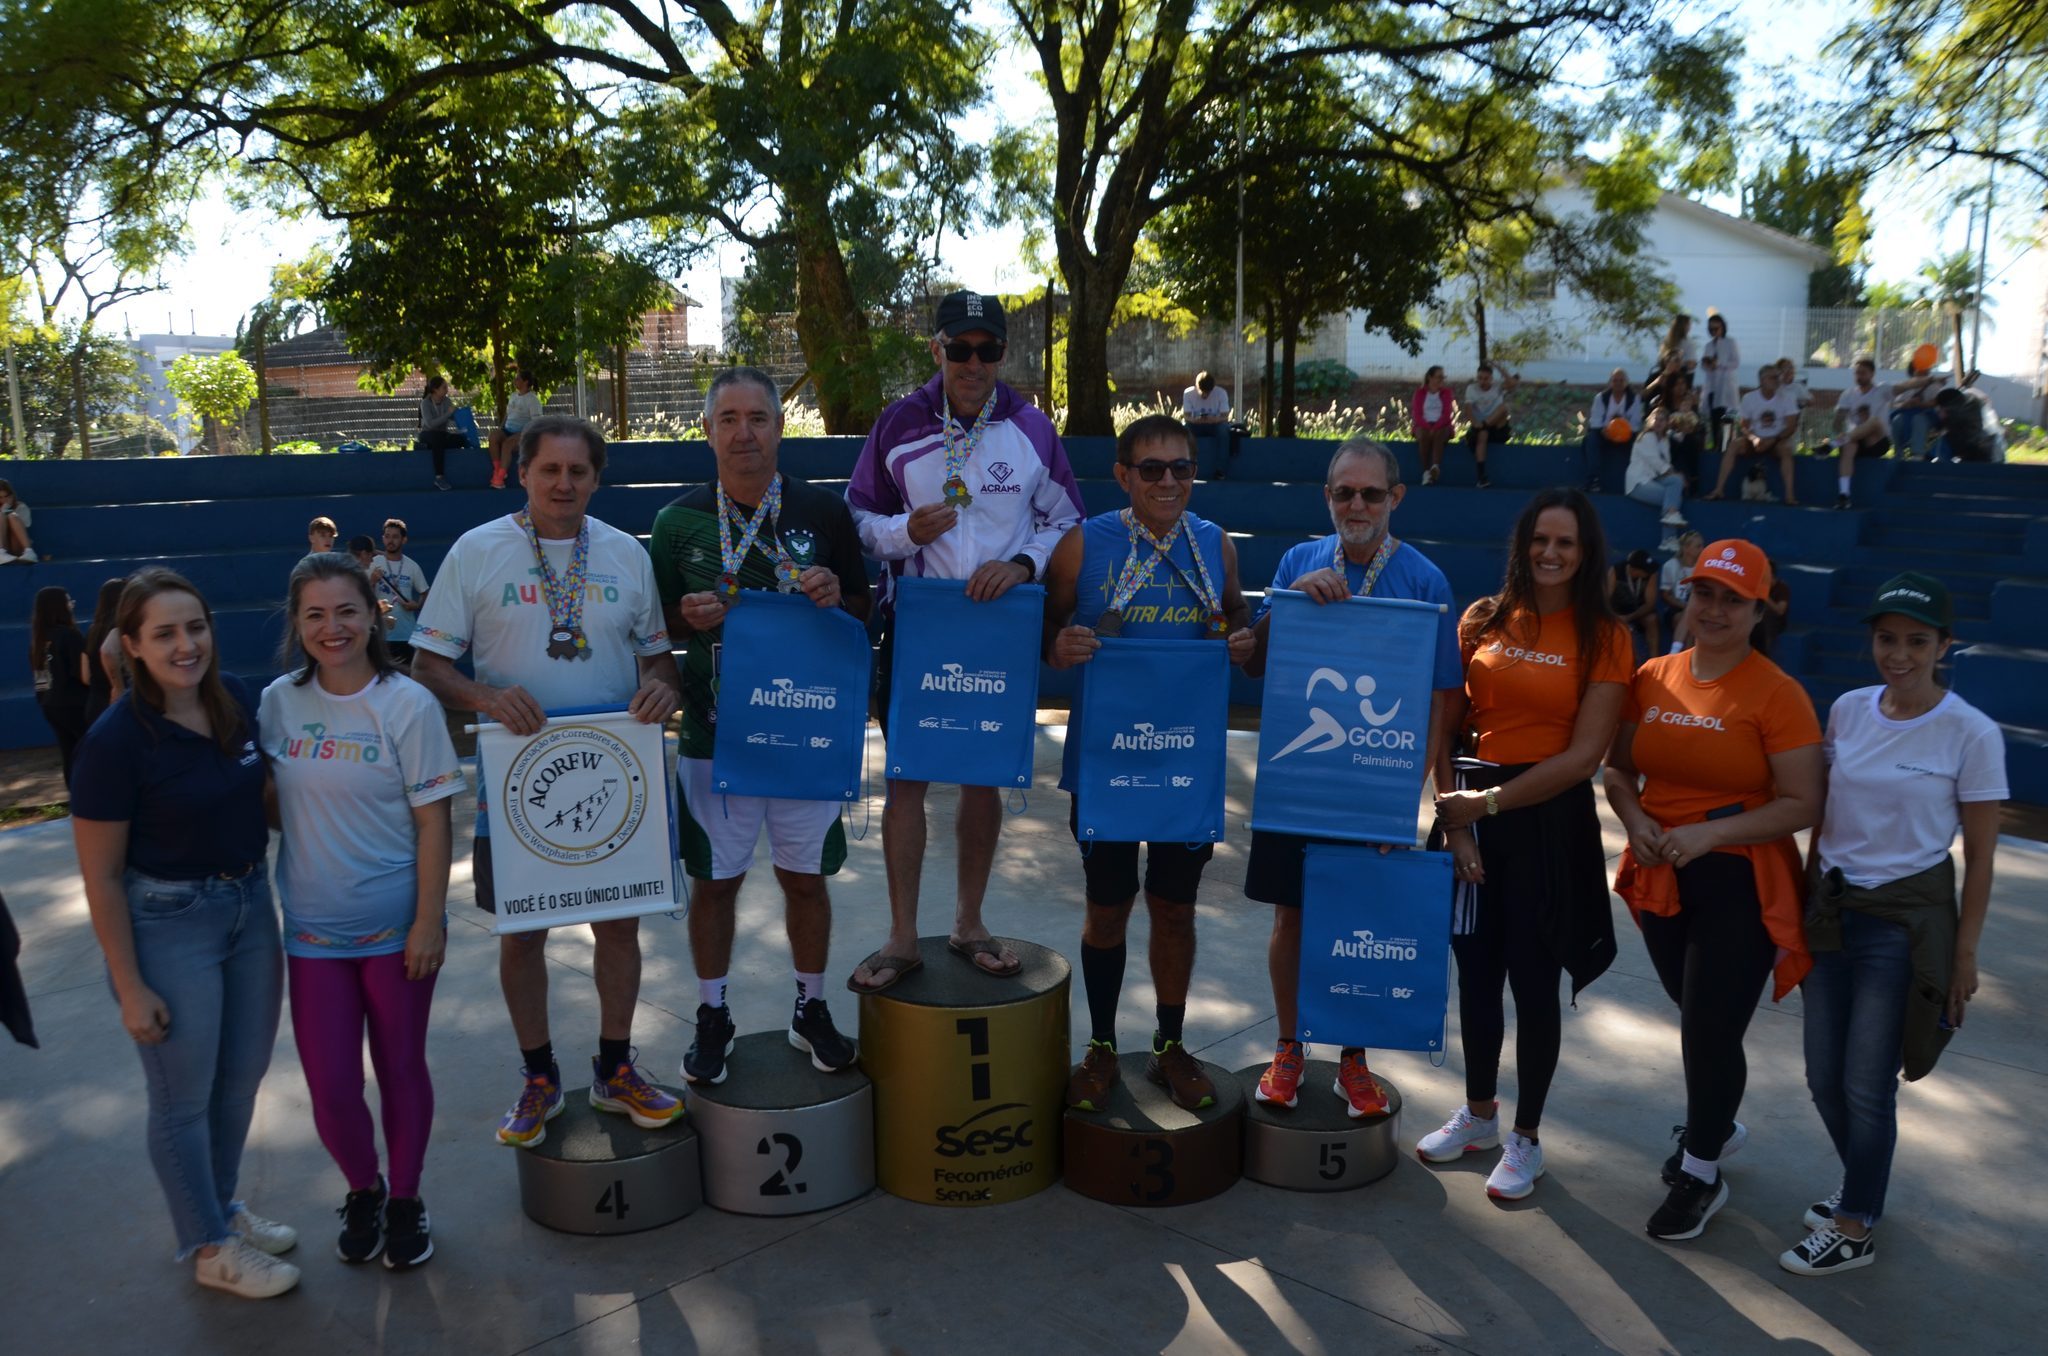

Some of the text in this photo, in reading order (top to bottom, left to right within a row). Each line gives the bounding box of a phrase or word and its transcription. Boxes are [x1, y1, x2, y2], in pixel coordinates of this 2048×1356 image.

[980, 484, 1021, 493] ACRAMS
[1704, 559, 1745, 576] CRESOL
[1120, 605, 1159, 623] UTRI
[1505, 646, 1568, 666] CRESOL
[921, 672, 1006, 694] Autismo
[749, 687, 837, 710] Autismo
[1661, 711, 1726, 731] CRESOL
[1111, 733, 1195, 750] Autismo
[1348, 726, 1415, 750] GCOR
[279, 737, 379, 763] Autismo
[513, 729, 633, 780] Associação de Corredores de Rua
[1352, 753, 1414, 769] Palmitinho
[529, 751, 604, 809] ACORFW
[510, 798, 530, 839] Frederico
[617, 814, 638, 841] Desde
[505, 880, 664, 915] VOCÊ É O SEU ÚNICO LIMITE!
[1332, 940, 1417, 961] Autismo
[956, 1016, 991, 1101] 1
[757, 1133, 807, 1196] 2
[934, 1161, 1034, 1183] Fecomércio
[1130, 1139, 1175, 1201] 3
[1319, 1142, 1347, 1180] 5
[595, 1180, 629, 1219] 4
[935, 1188, 991, 1202] Senac
